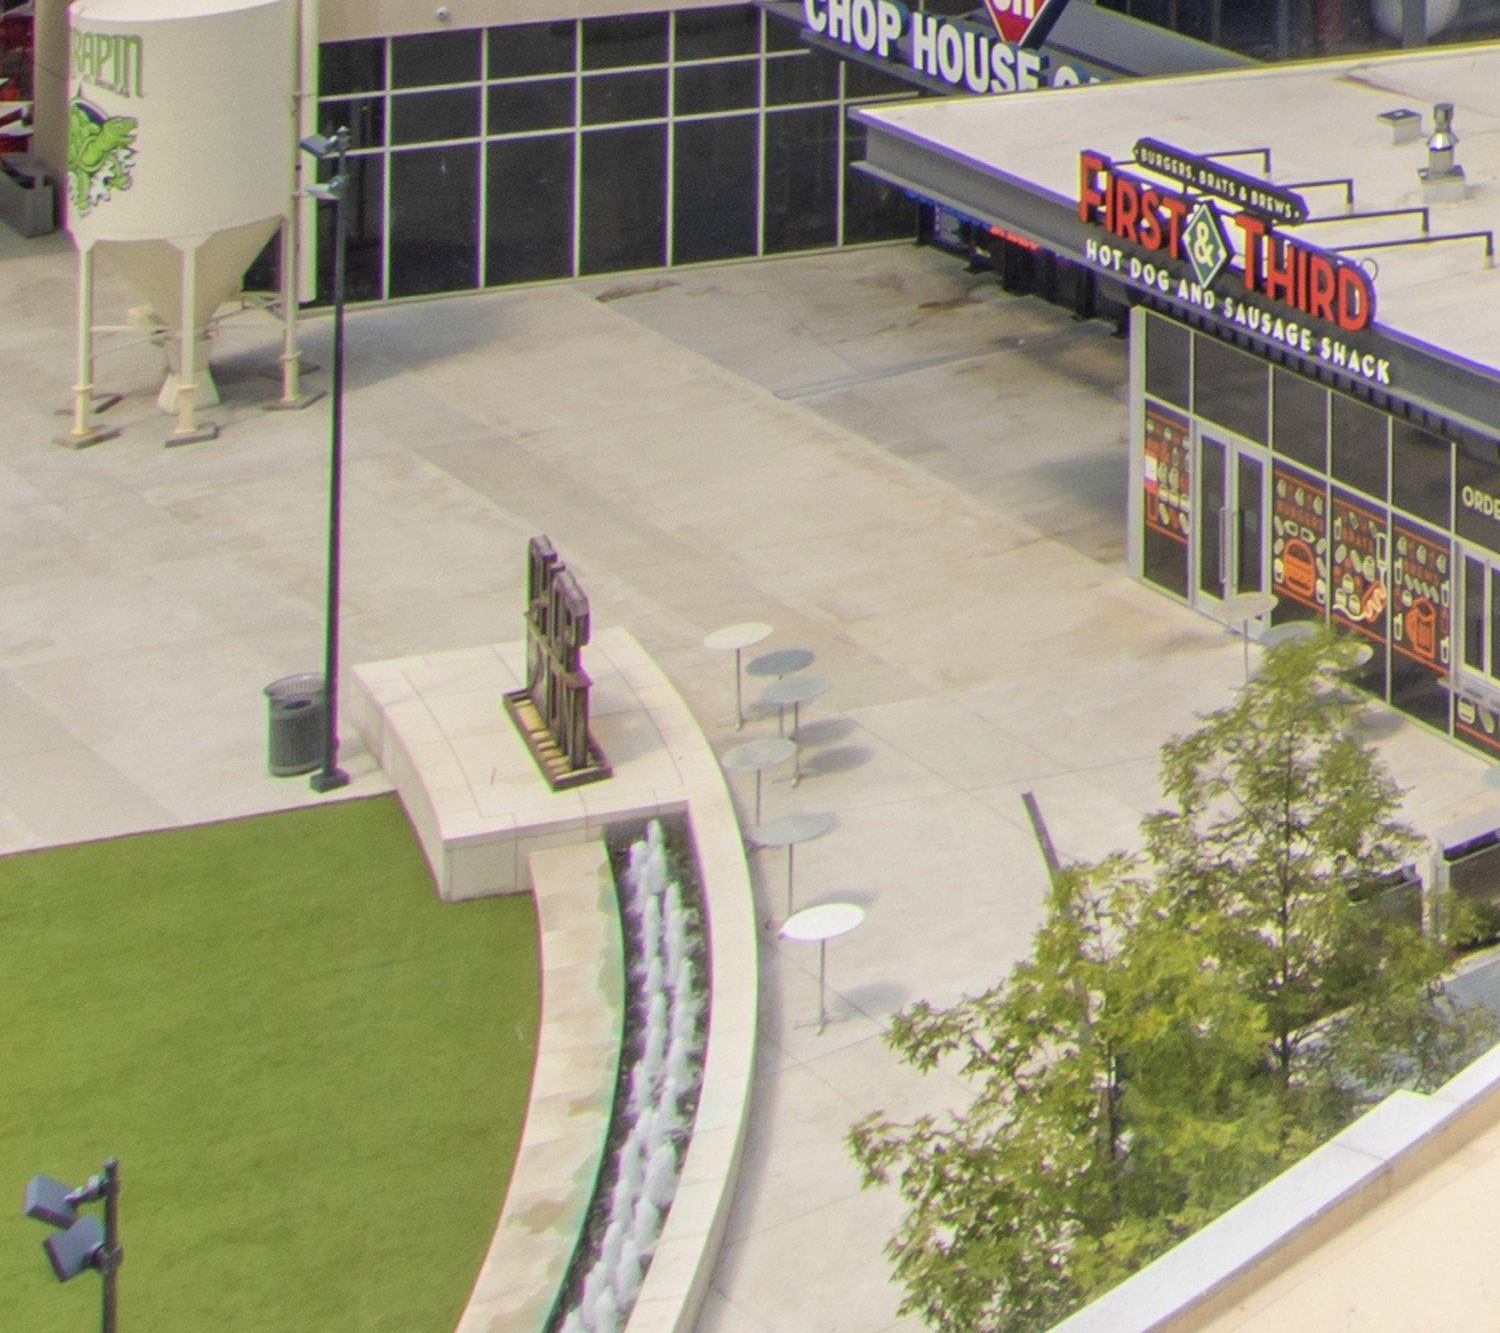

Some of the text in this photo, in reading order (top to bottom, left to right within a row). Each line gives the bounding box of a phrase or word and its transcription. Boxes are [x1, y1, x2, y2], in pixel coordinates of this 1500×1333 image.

[912, 12, 1041, 94] HOUSE
[1199, 169, 1236, 198] BRATS
[1078, 154, 1370, 331] FIRST & THIRD
[1085, 238, 1390, 385] HOT DOG AND SAUSAGE SHACK
